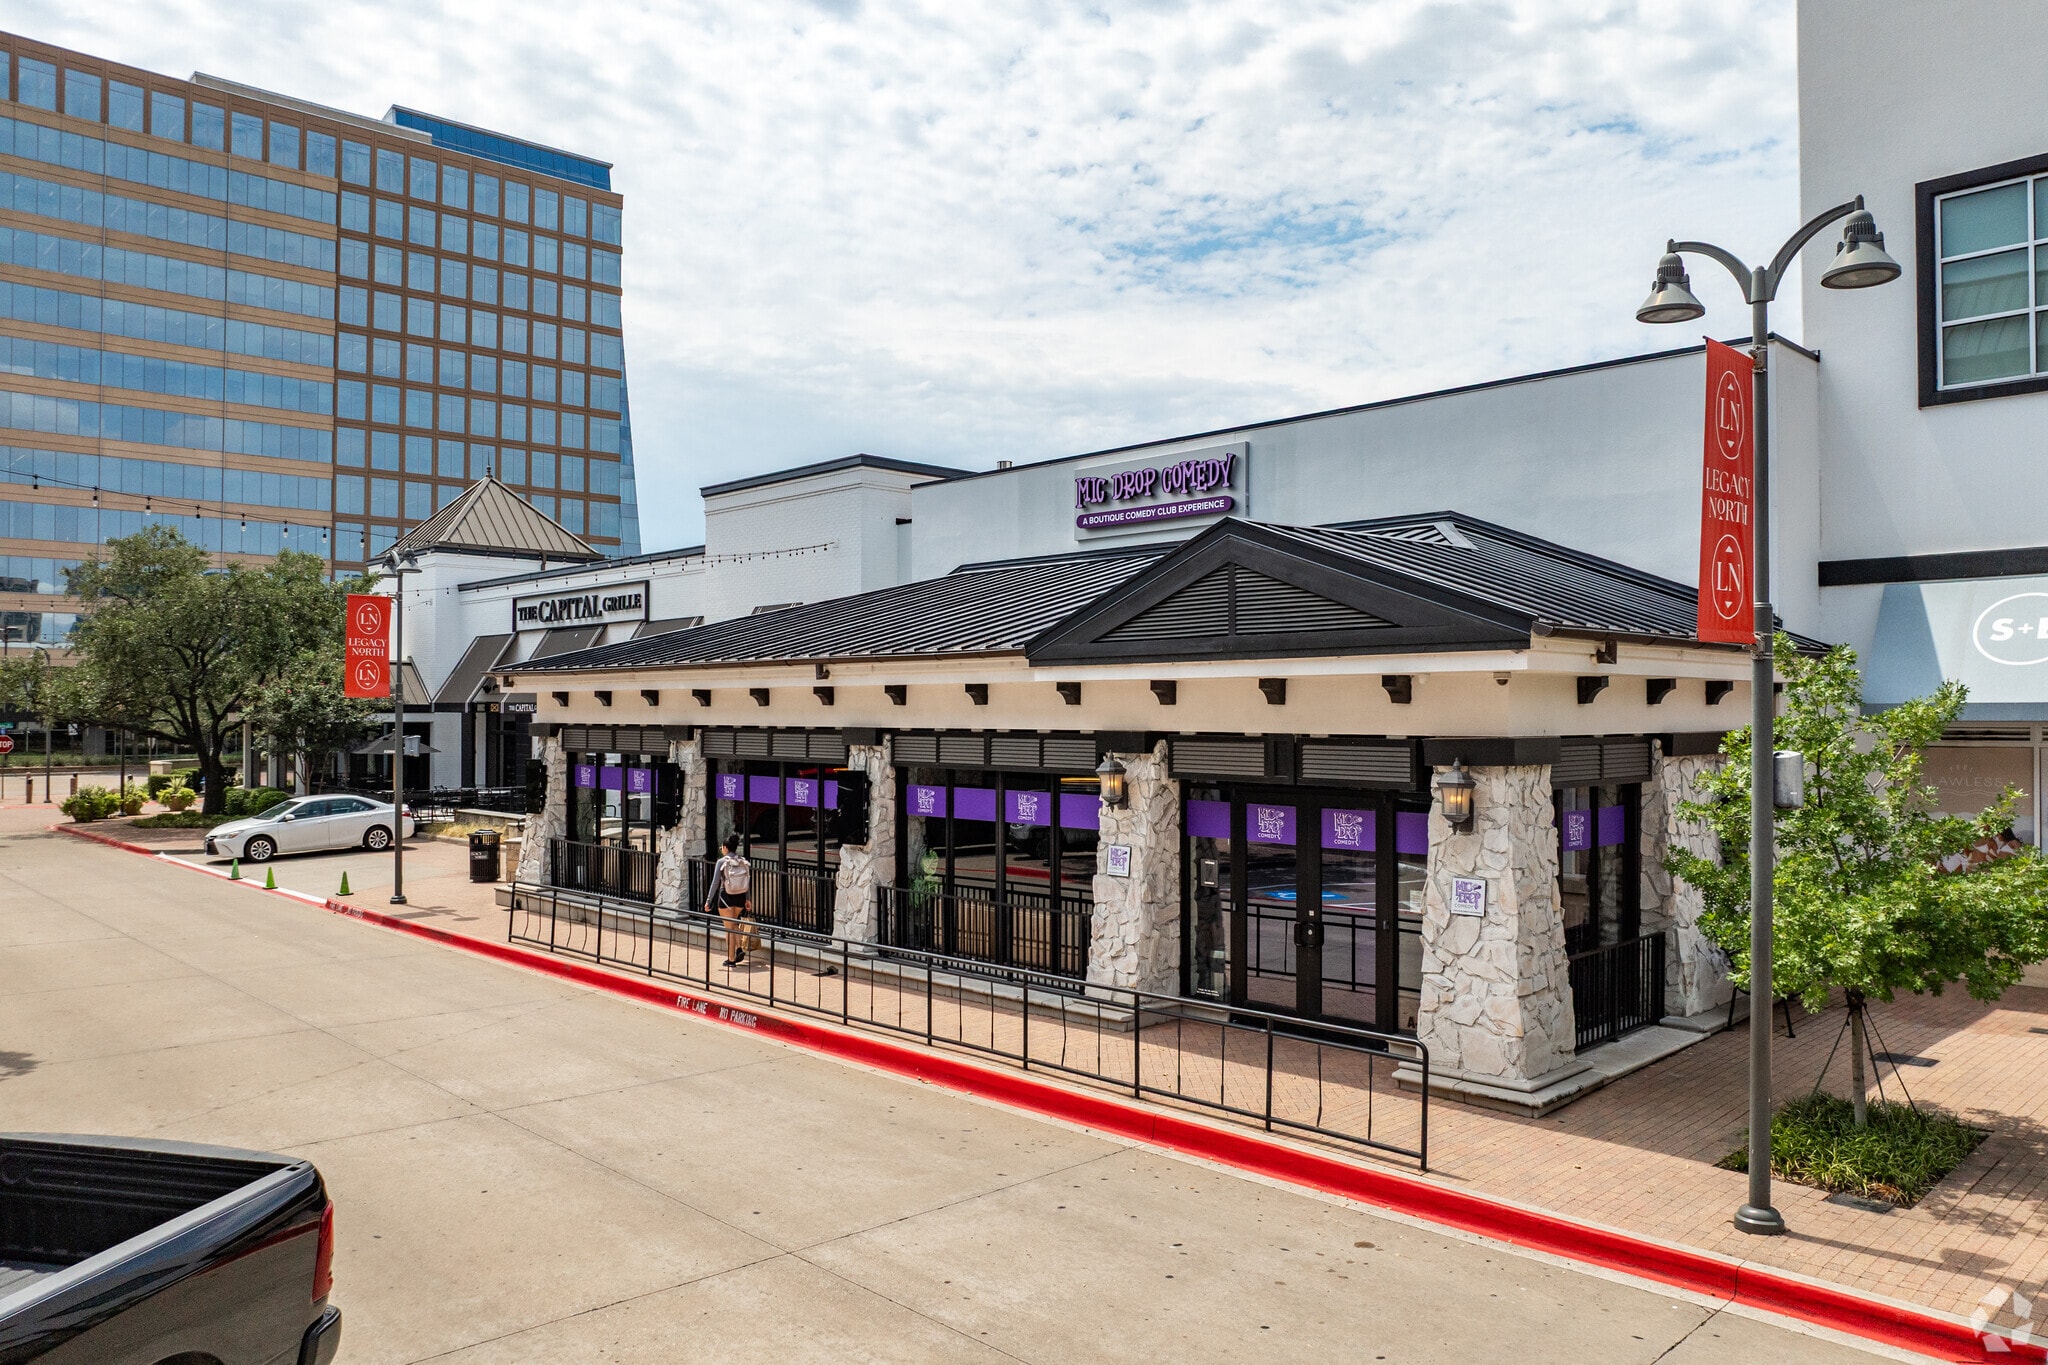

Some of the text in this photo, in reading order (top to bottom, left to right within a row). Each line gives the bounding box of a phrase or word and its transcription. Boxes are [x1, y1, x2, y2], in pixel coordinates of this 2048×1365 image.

[1720, 398, 1740, 433] LN
[1075, 453, 1236, 509] MIC DROP COMEDY
[1706, 467, 1751, 499] LEGACY
[1089, 513, 1125, 524] BOUTIQUE
[1125, 509, 1156, 519] COMEDY
[1157, 506, 1177, 516] CLUB
[1178, 500, 1225, 513] EXPERIENCE
[1709, 496, 1748, 525] NORTH
[1717, 561, 1741, 592] LN
[360, 613, 378, 625] LN
[518, 593, 642, 622] THE CAPITAL GRILLE
[348, 638, 387, 647] LEGACY
[352, 647, 384, 656] NORTH
[359, 669, 376, 680] LN
[677, 996, 757, 1028] FIRE LANE NO PARKING
